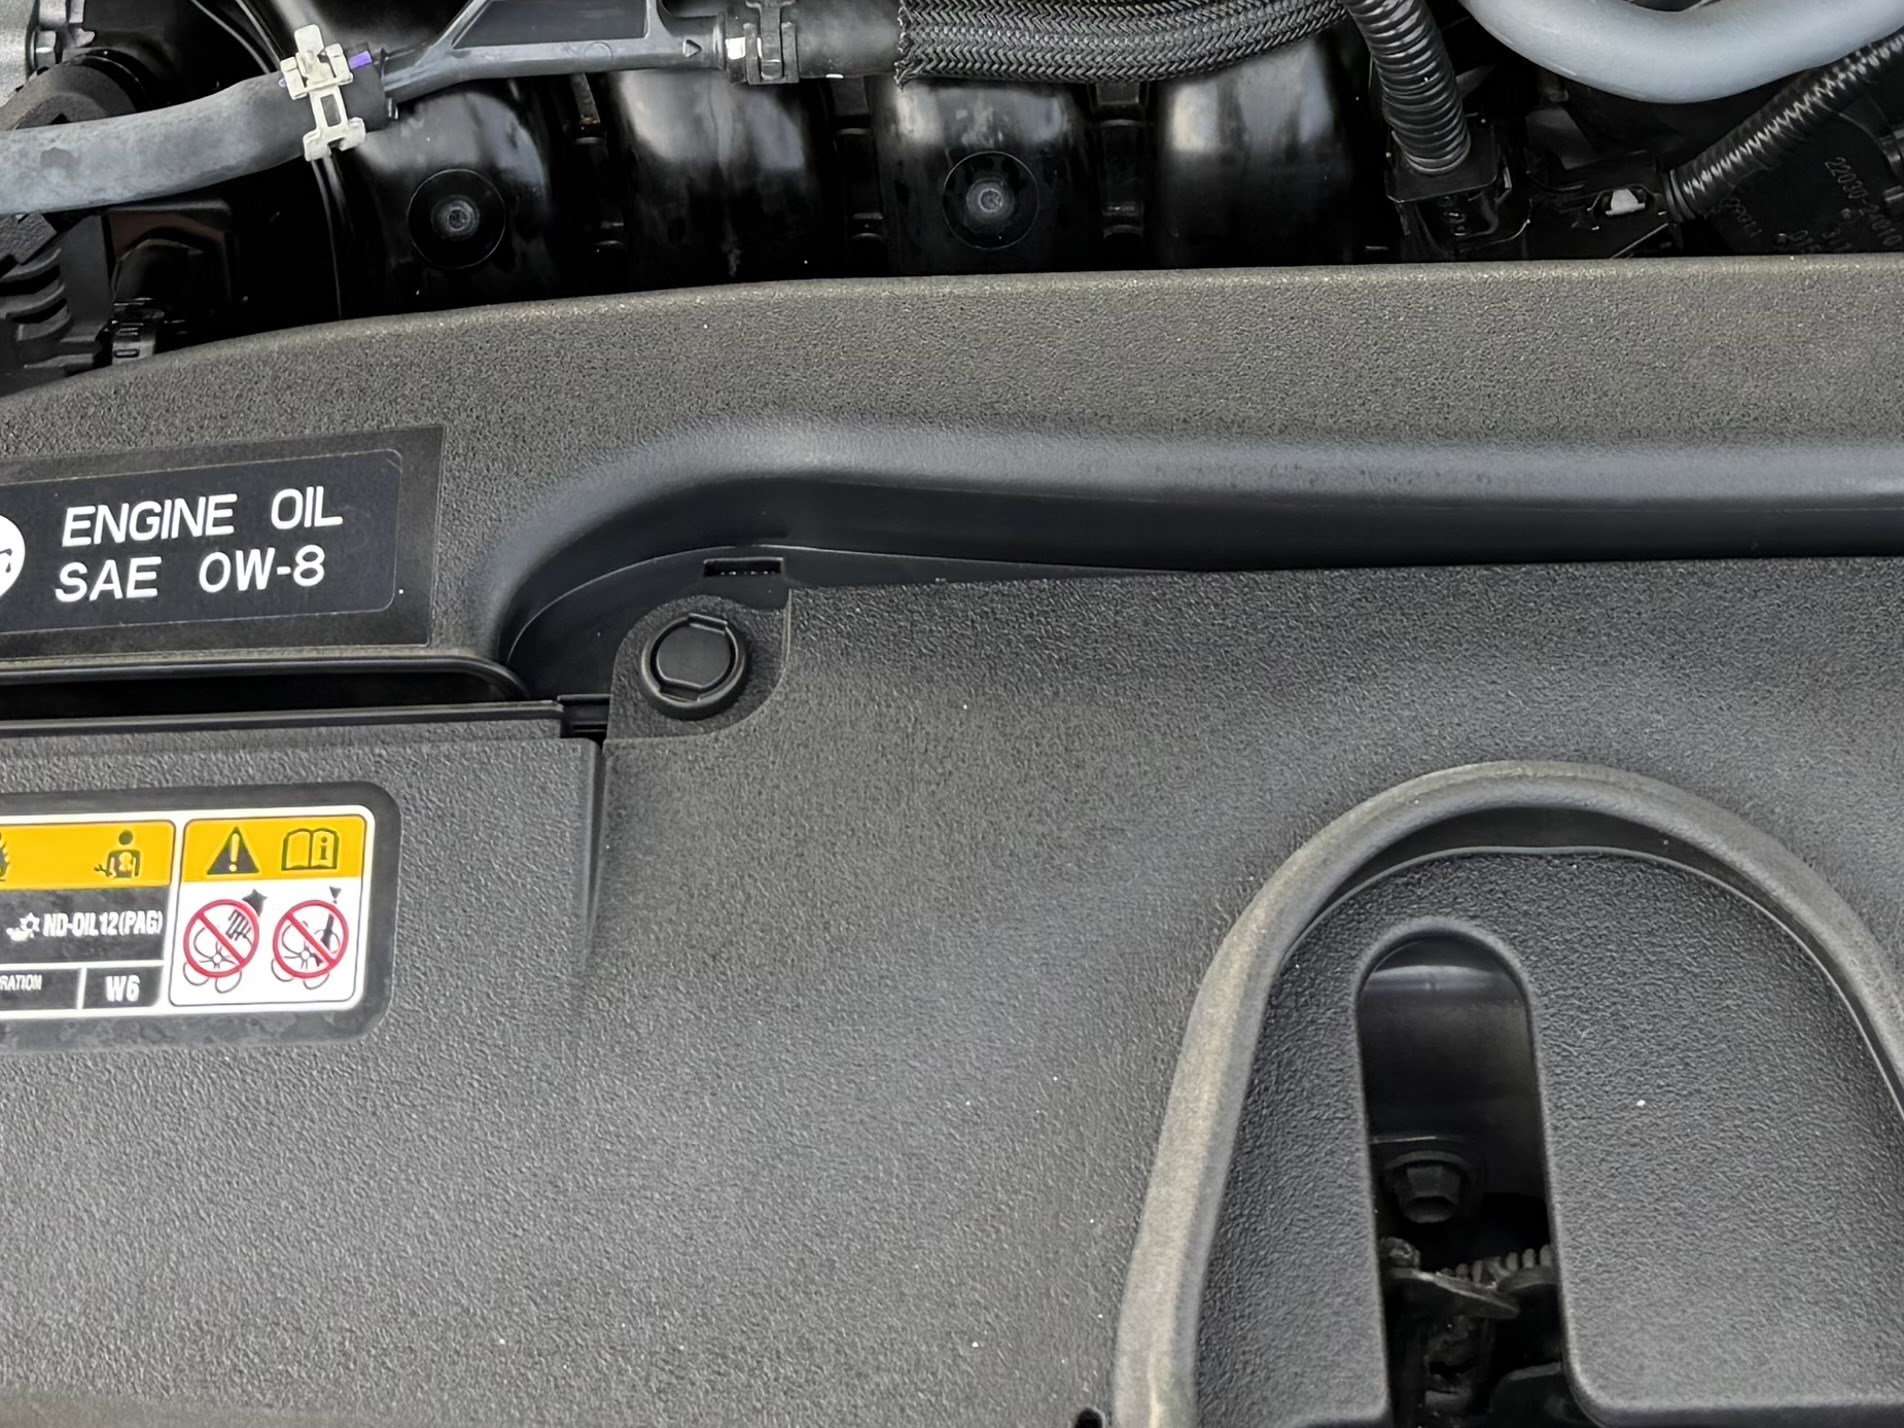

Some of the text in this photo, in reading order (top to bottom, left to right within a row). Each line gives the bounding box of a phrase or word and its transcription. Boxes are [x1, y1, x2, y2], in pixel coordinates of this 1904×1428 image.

[61, 485, 344, 548] ENGINE OIL
[54, 544, 327, 604] SAE 0W-8
[104, 975, 140, 1003] W6
